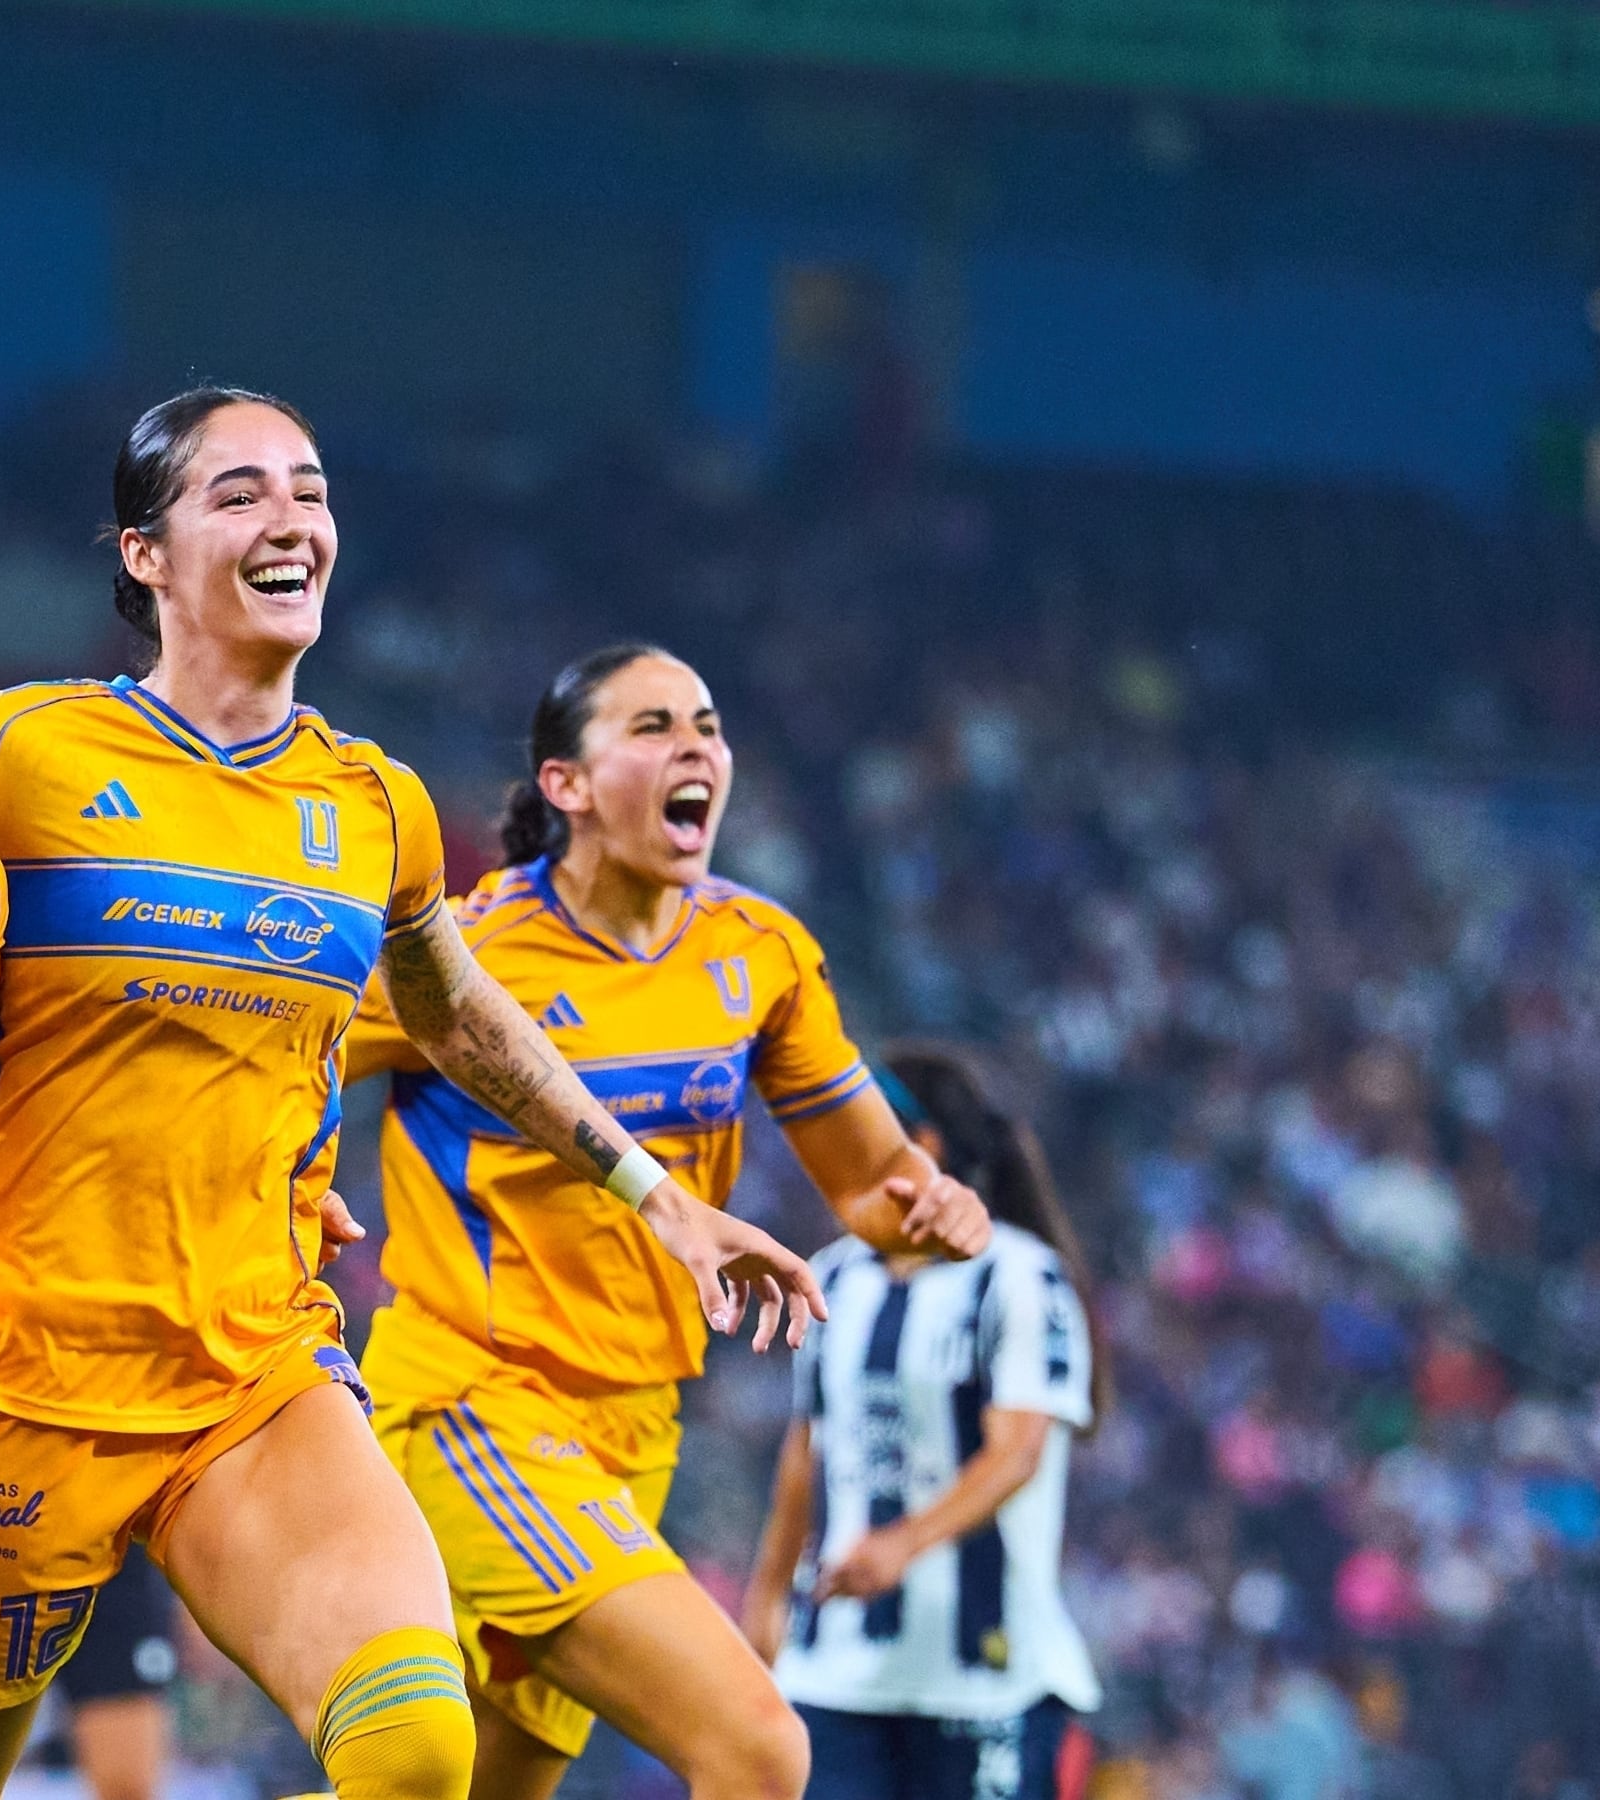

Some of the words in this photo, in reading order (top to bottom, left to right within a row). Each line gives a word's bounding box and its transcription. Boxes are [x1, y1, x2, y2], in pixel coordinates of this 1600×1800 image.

[295, 797, 339, 863] U
[134, 903, 225, 931] CEMEX
[245, 909, 325, 946] Vertua
[120, 975, 311, 1023] SPORTIUMBET
[705, 957, 752, 1018] U
[600, 1092, 665, 1114] EMEX
[0, 1585, 97, 1681] 12
